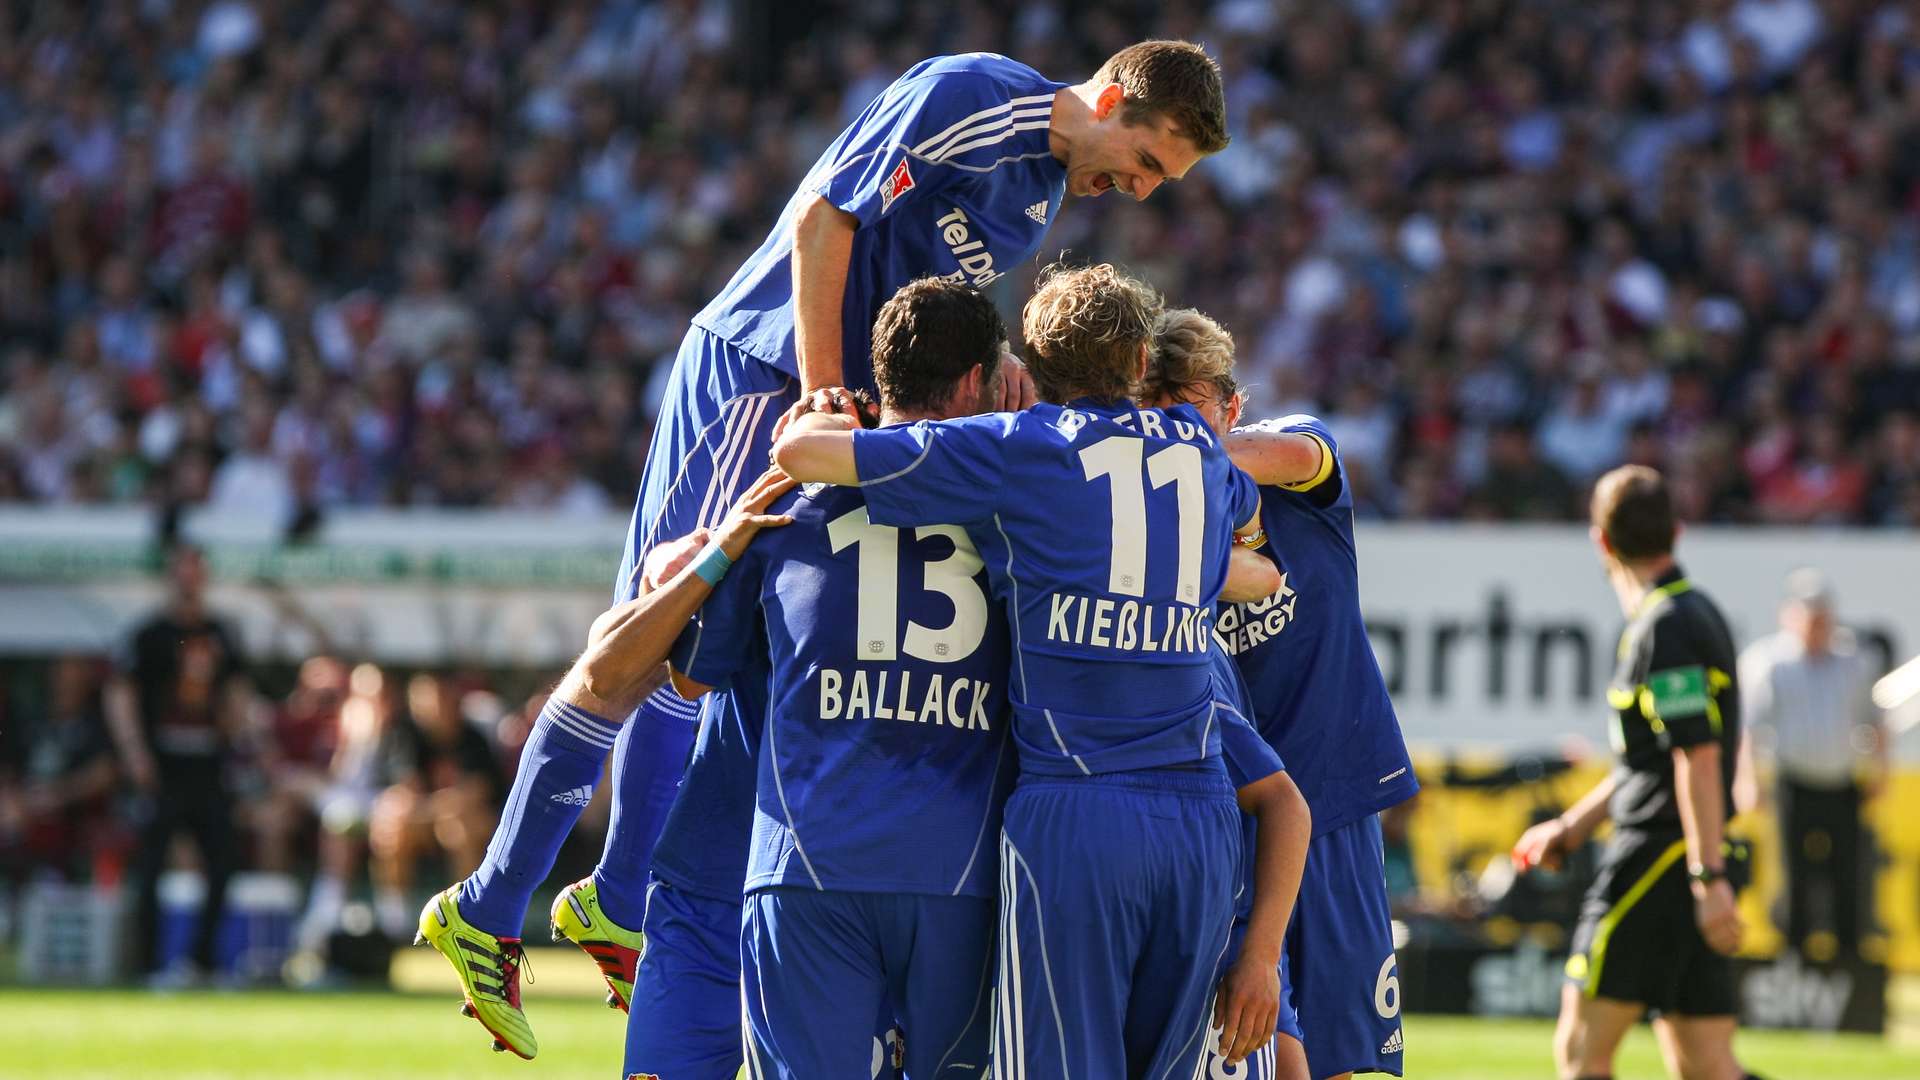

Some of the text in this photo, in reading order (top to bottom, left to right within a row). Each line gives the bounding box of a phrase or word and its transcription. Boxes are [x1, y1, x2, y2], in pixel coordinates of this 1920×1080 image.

[1078, 436, 1205, 606] 11
[826, 505, 988, 663] 13
[1047, 593, 1210, 654] KIEßLING
[819, 669, 991, 731] BALLACK
[1375, 952, 1401, 1019] 6
